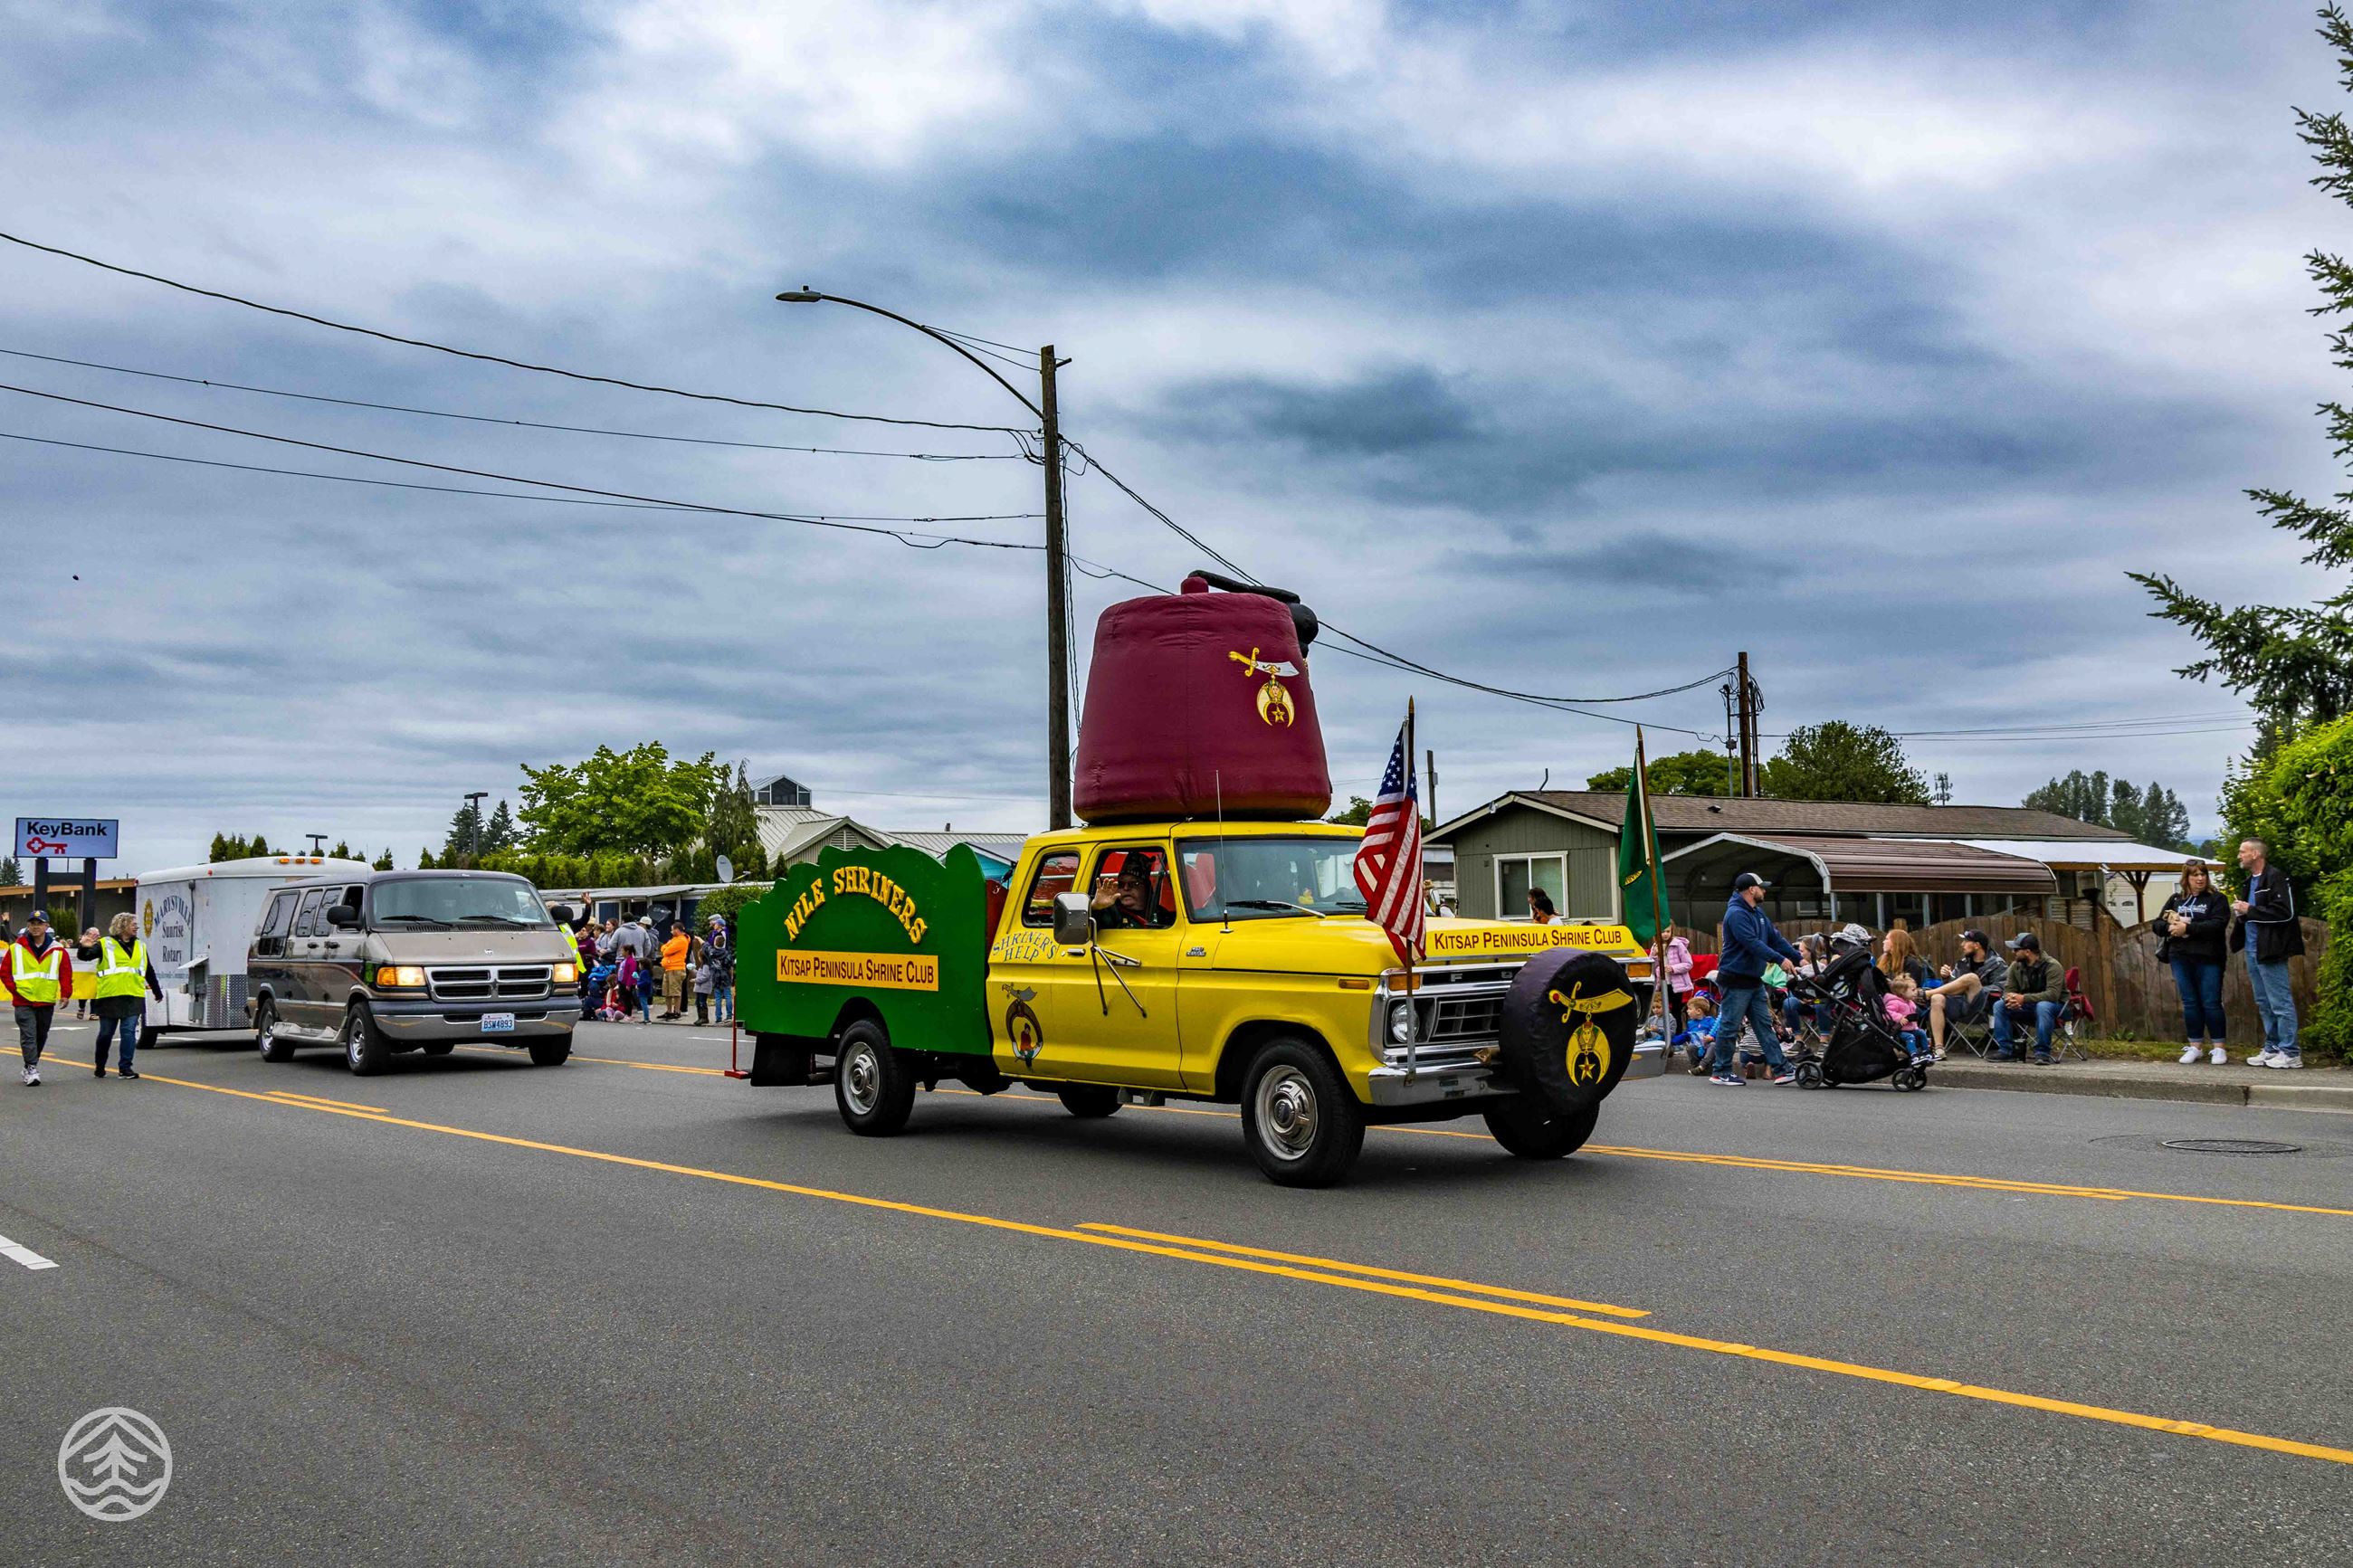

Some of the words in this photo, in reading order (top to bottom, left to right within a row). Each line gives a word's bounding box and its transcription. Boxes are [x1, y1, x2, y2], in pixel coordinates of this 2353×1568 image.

[27, 822, 108, 838] KeyBank
[784, 878, 825, 942] NILE
[833, 866, 928, 944] SHRINERS
[162, 921, 184, 938] Sunrise
[1434, 933, 1479, 949] KITSAP
[1483, 930, 1548, 948] PENINSULA
[1551, 929, 1591, 946] SHRINE
[1594, 928, 1622, 944] CLUB
[993, 931, 1057, 959] SHRINER'S
[1004, 945, 1039, 962] HELP
[162, 946, 182, 966] Rotary
[780, 955, 811, 977] KITSAP
[814, 957, 864, 981] PENINSULA
[866, 959, 903, 983] SHRINE
[906, 961, 934, 984] CLUB
[483, 1020, 513, 1029] BSW4893
